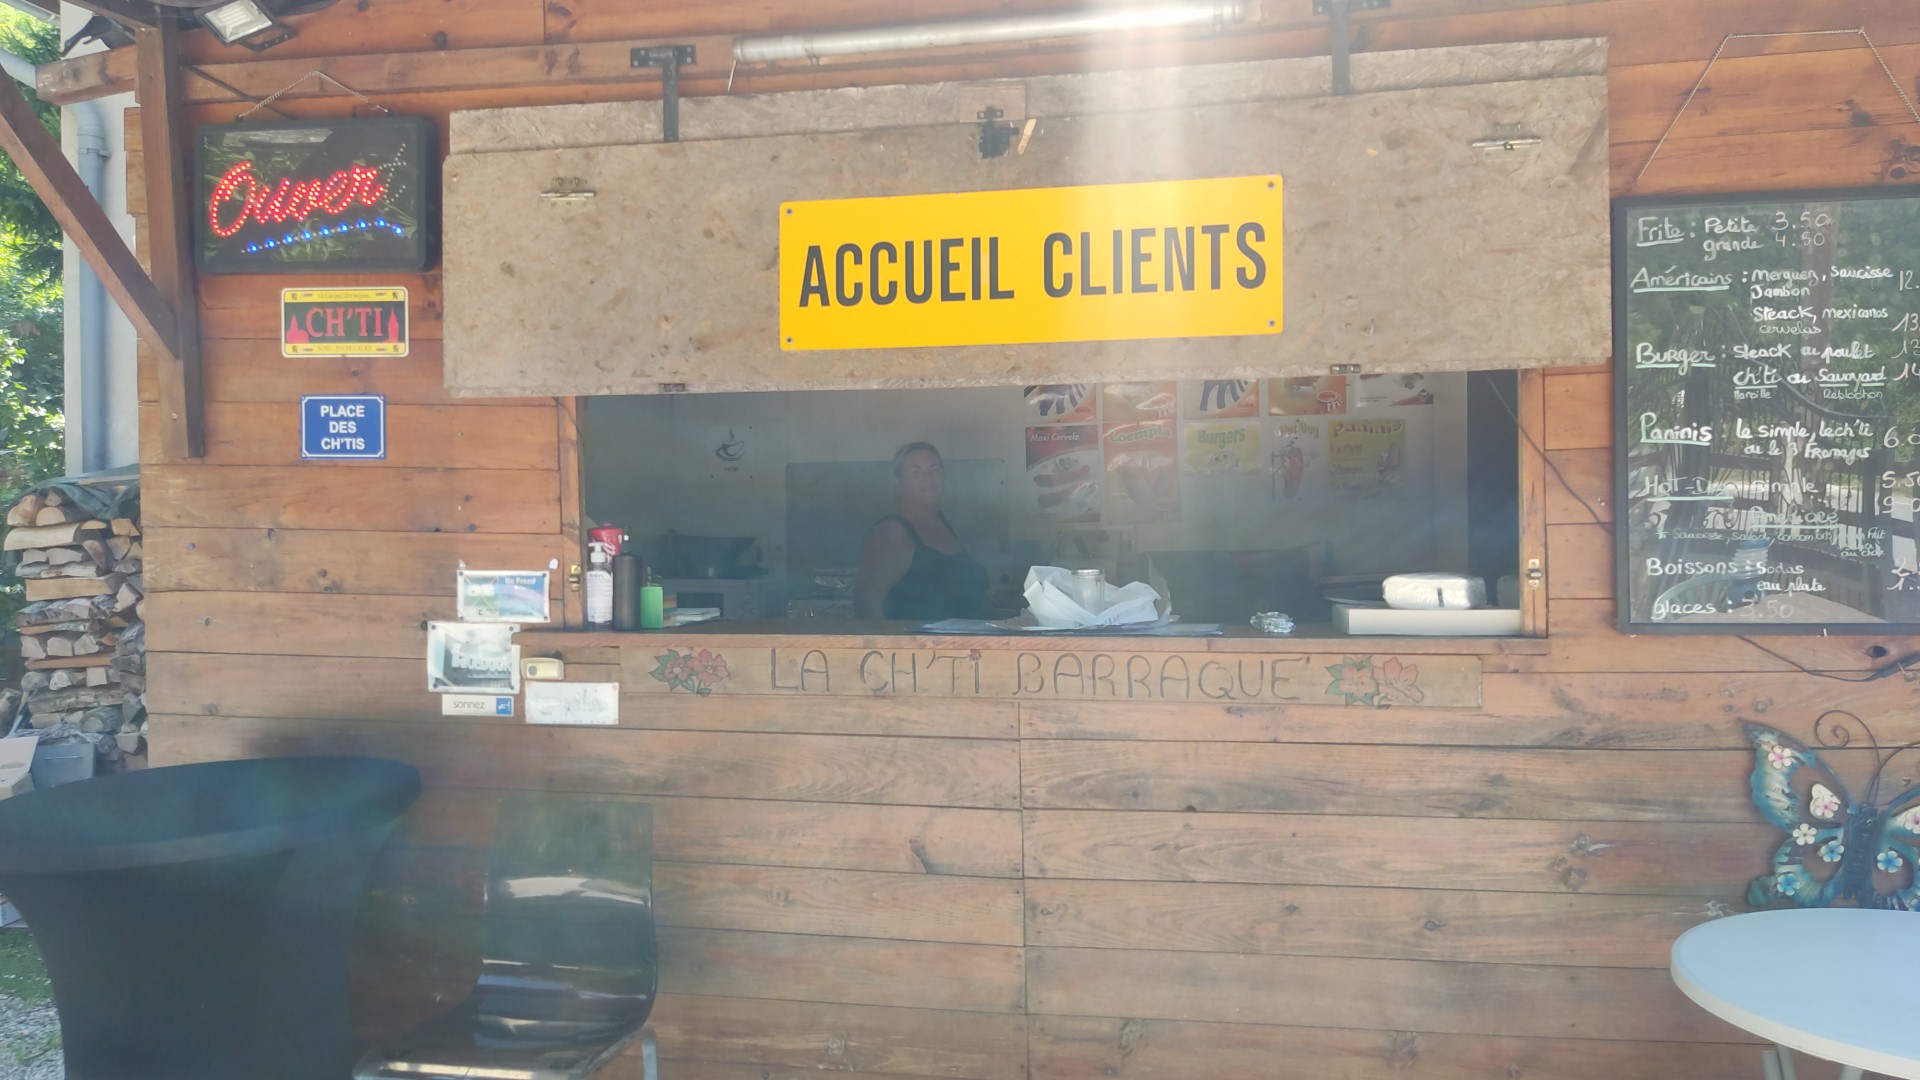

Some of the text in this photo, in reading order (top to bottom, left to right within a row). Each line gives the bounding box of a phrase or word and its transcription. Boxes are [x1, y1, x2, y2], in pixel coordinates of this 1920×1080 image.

[1705, 217, 1759, 234] Petite
[1703, 235, 1763, 261] grande
[799, 222, 1266, 308] ACCUEIL CLIENTS
[1750, 284, 1810, 299] Jambon
[305, 306, 383, 337] CH'TI
[1820, 341, 1876, 364] poulet
[320, 405, 366, 418] PLACE
[329, 422, 357, 434] DES
[1109, 427, 1172, 443] Loempia
[321, 438, 366, 451] CH'TIS
[1198, 428, 1245, 448] Burgers
[1788, 578, 1826, 598] plate
[771, 648, 831, 692] LA
[453, 701, 485, 710] sonnez
